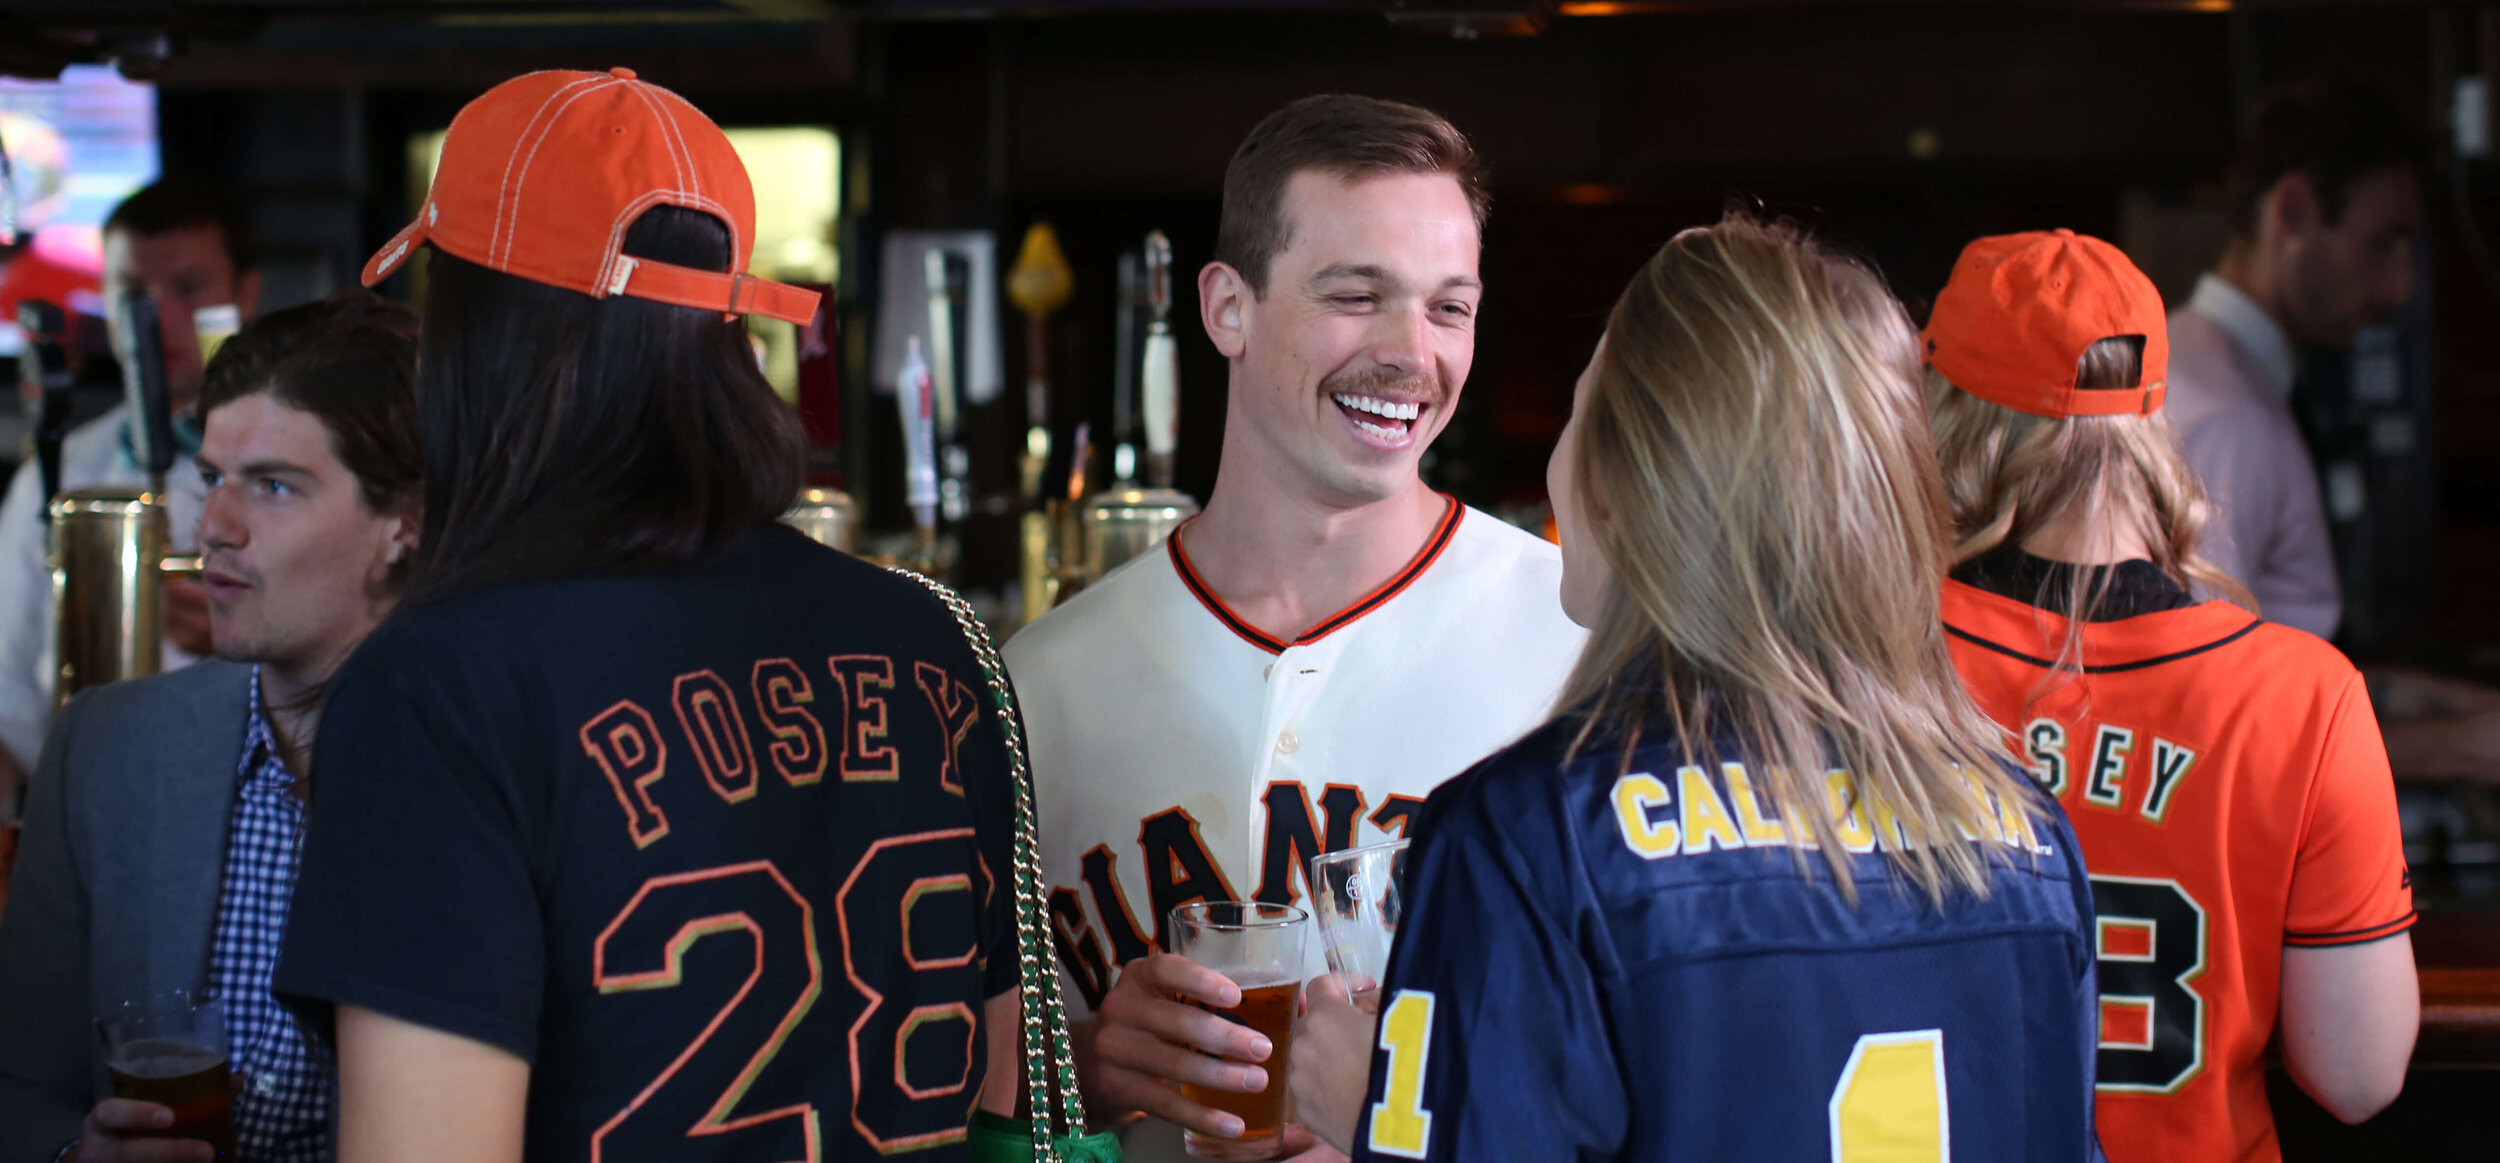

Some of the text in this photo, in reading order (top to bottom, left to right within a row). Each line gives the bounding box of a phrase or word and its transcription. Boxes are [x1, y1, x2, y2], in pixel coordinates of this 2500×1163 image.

[579, 654, 979, 849] POSEY
[1610, 761, 2038, 860] CALIOIA
[2024, 717, 2196, 825] SEY
[1047, 780, 1427, 1014] GIANT
[2088, 873, 2208, 1097] 8
[591, 828, 995, 1163] 28
[1368, 988, 1436, 1160] 1
